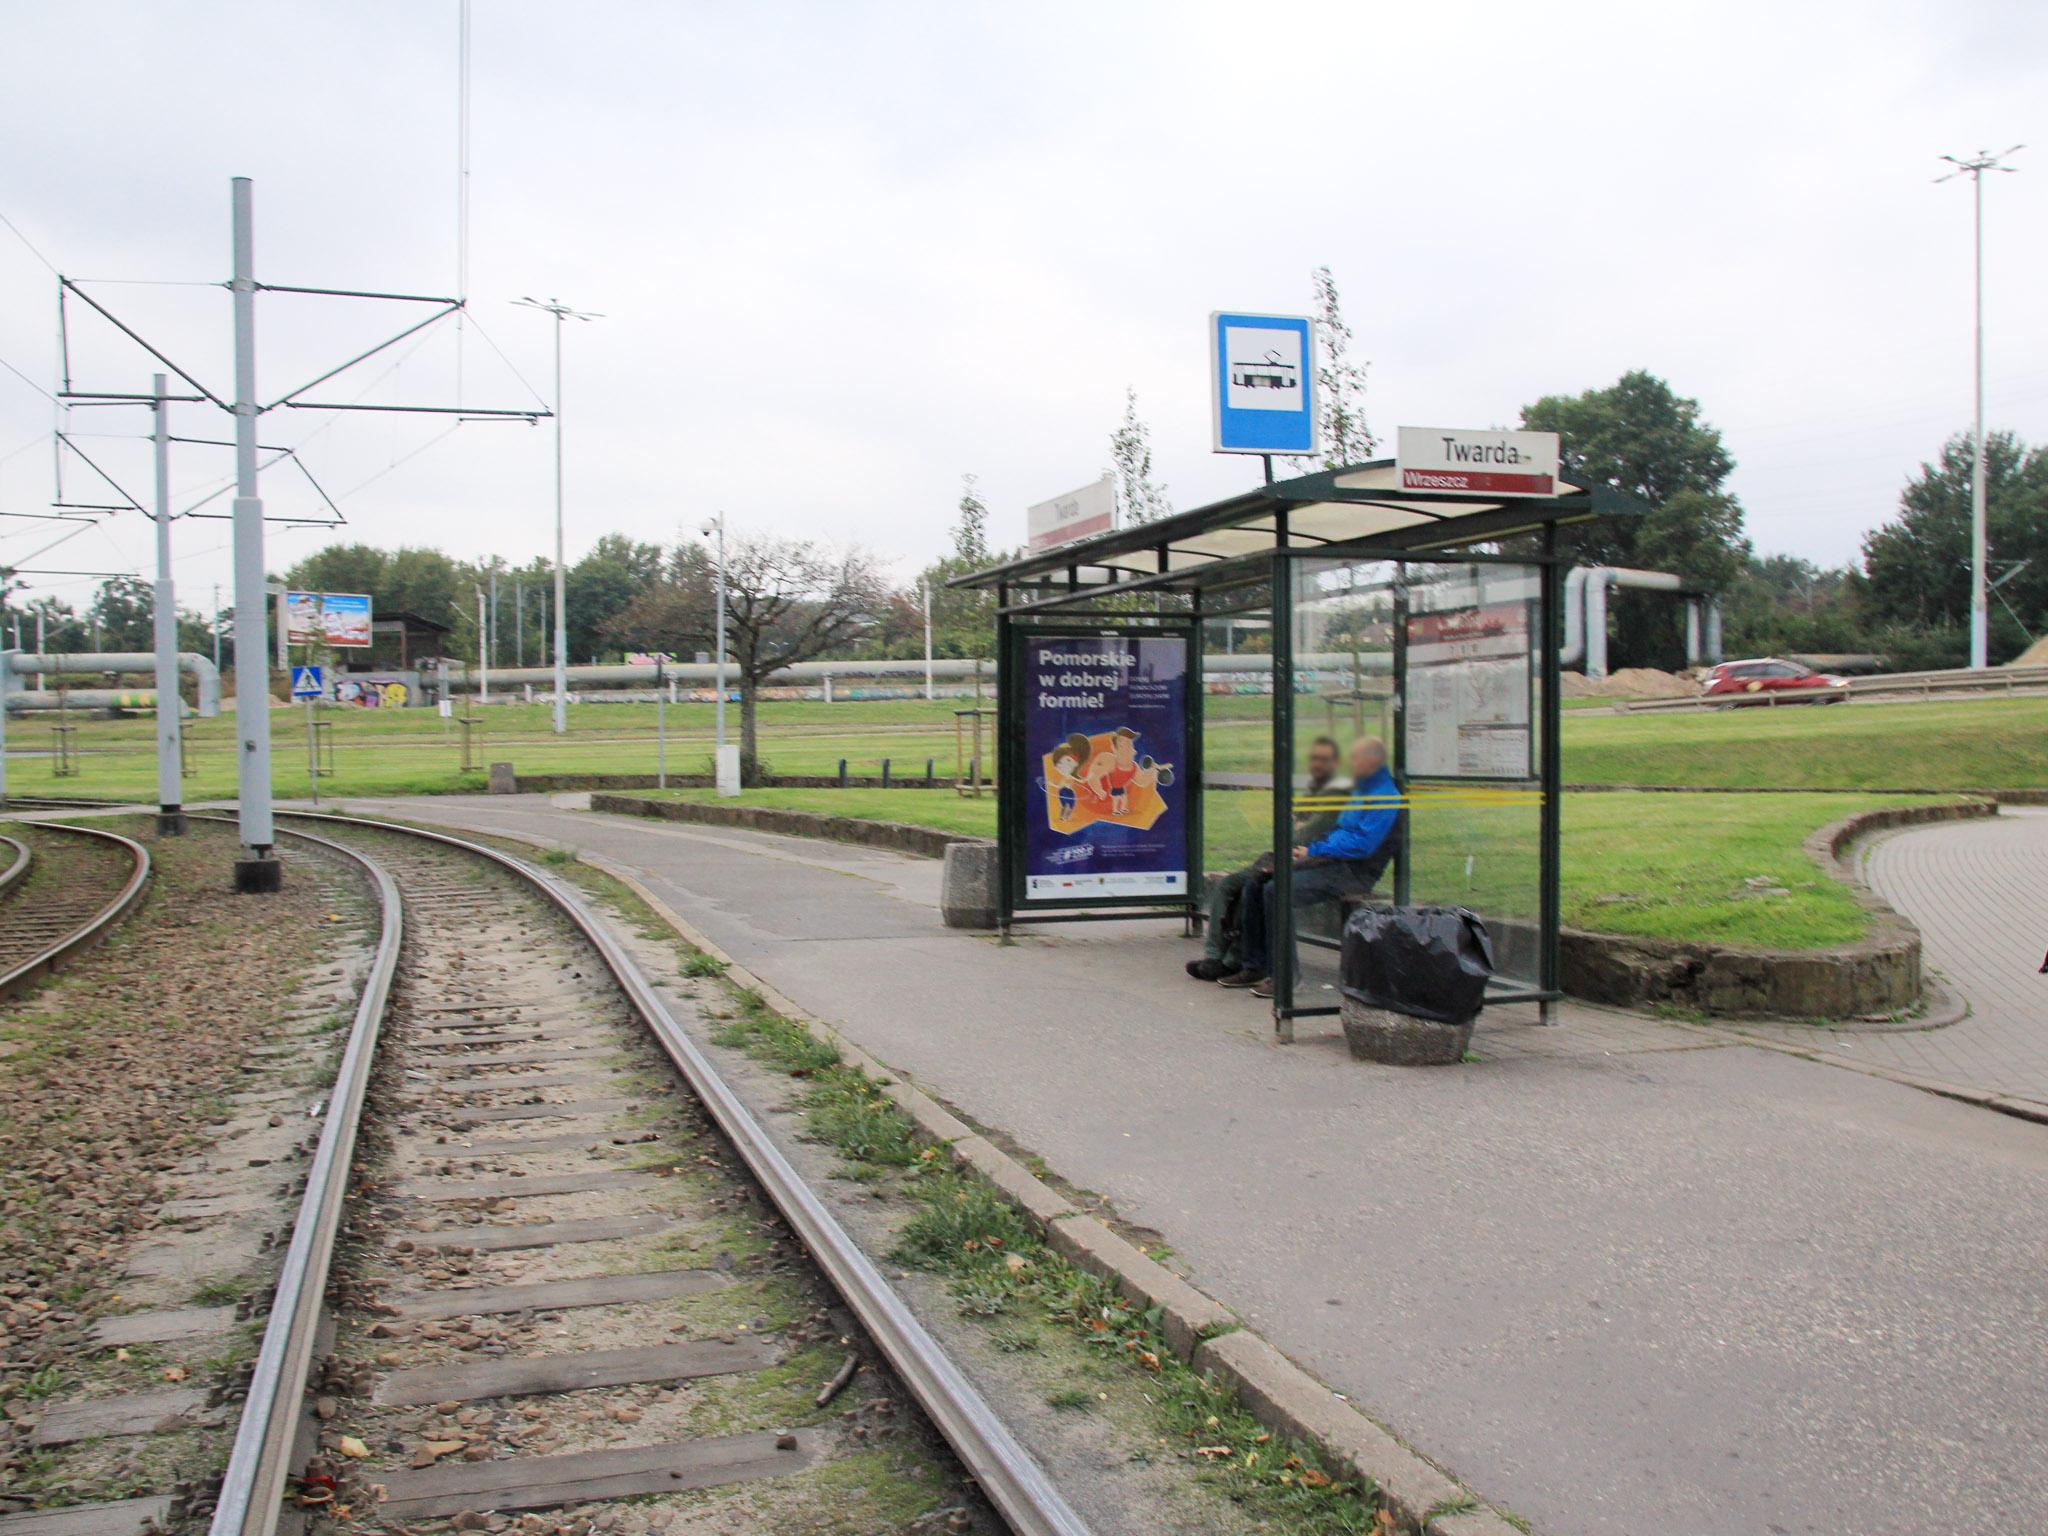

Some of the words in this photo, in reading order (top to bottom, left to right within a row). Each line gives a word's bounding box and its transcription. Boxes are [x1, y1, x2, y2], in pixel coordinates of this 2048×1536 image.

[1442, 437, 1519, 464] Twarda
[1404, 471, 1469, 488] Wrzeszcz
[1039, 649, 1136, 667] Pomorskie
[1038, 674, 1056, 687] w
[1059, 671, 1119, 691] dobrej
[1038, 691, 1105, 708] formie!
